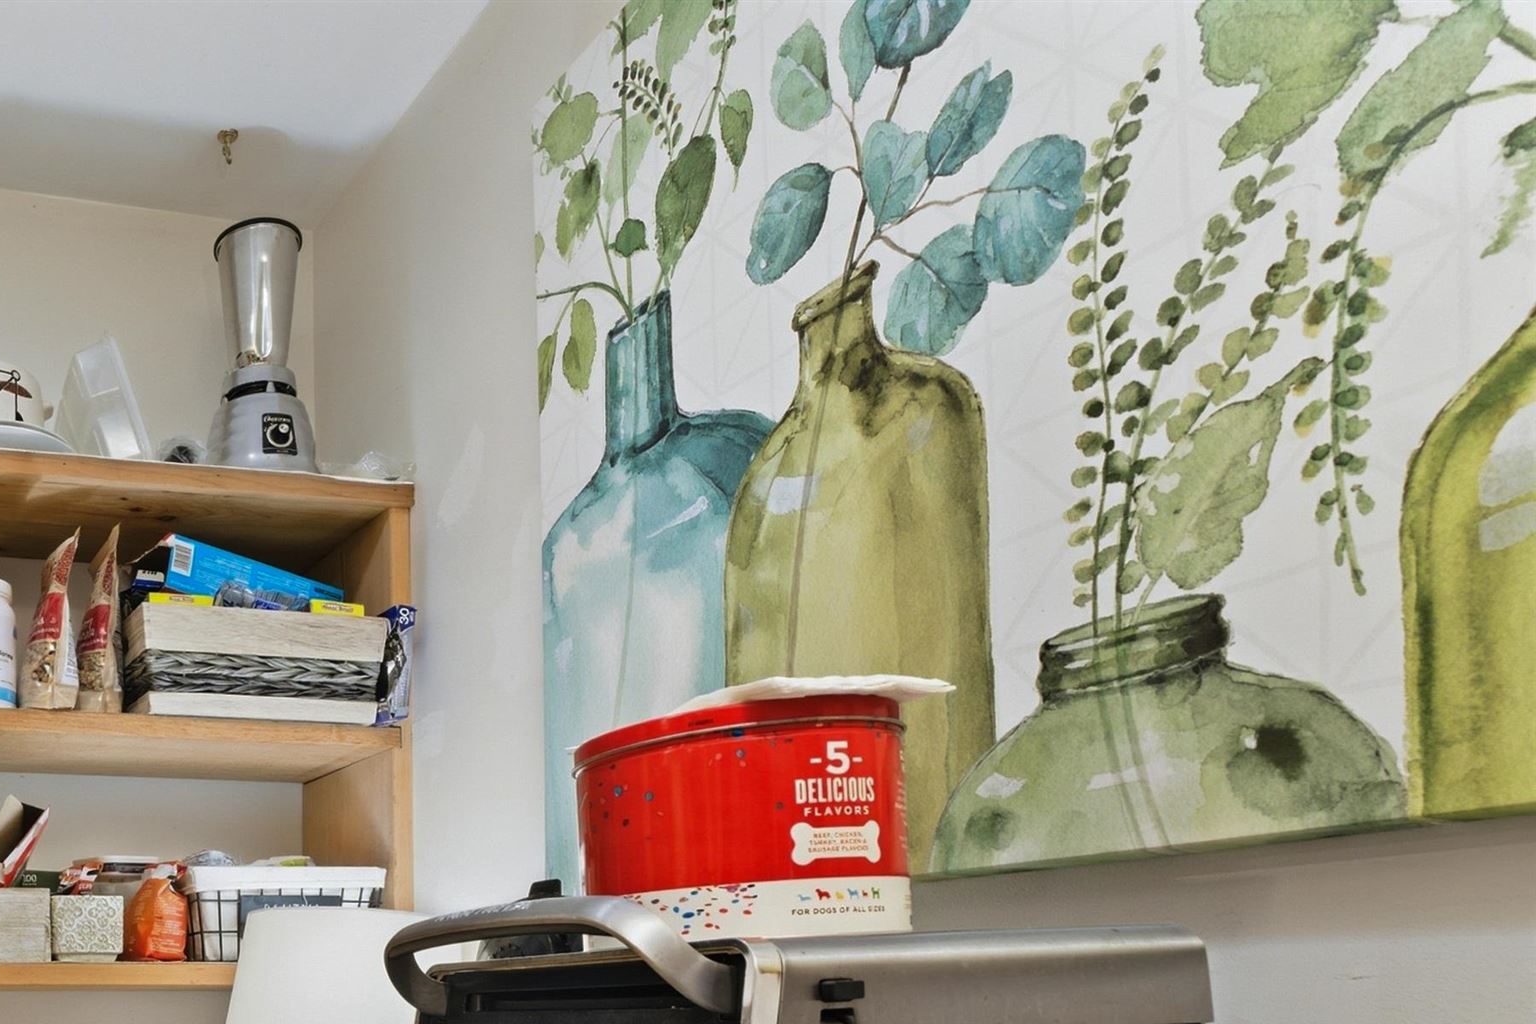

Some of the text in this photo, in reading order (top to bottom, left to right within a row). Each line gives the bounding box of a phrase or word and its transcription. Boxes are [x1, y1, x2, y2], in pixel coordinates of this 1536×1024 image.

[399, 608, 410, 625] 30
[794, 777, 876, 805] DELICIOUS
[803, 805, 870, 817] FLAVORS
[791, 908, 810, 917] FOR
[813, 906, 837, 915] DOGS
[839, 906, 851, 914] OF
[852, 905, 866, 913] ALL
